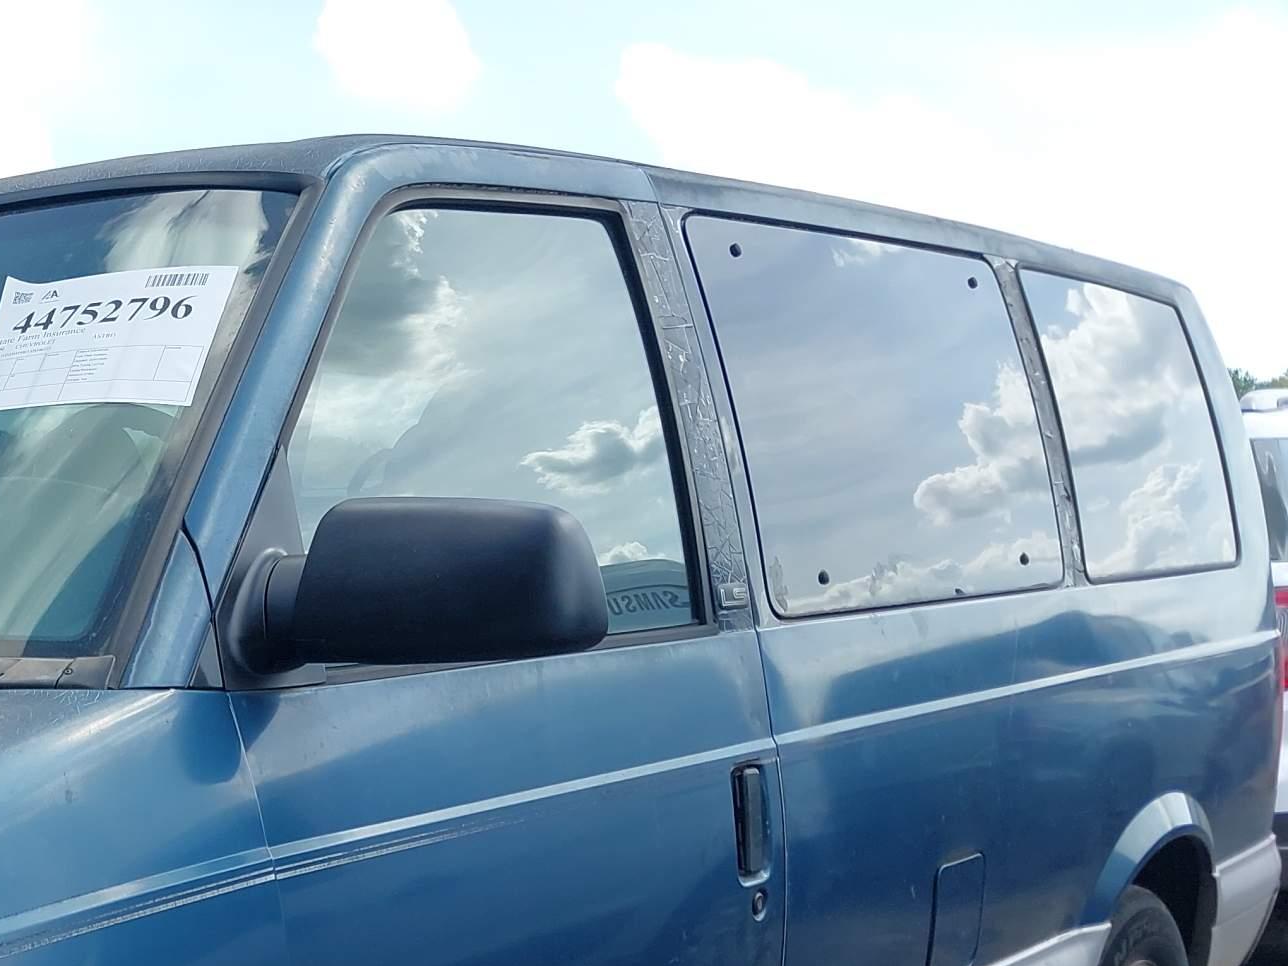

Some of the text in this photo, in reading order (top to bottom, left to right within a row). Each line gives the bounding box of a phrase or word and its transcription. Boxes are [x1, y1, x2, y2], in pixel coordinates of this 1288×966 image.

[12, 295, 199, 334] 44752796
[17, 333, 41, 343] Farm
[42, 327, 86, 339] Insurance
[720, 587, 746, 607] LS
